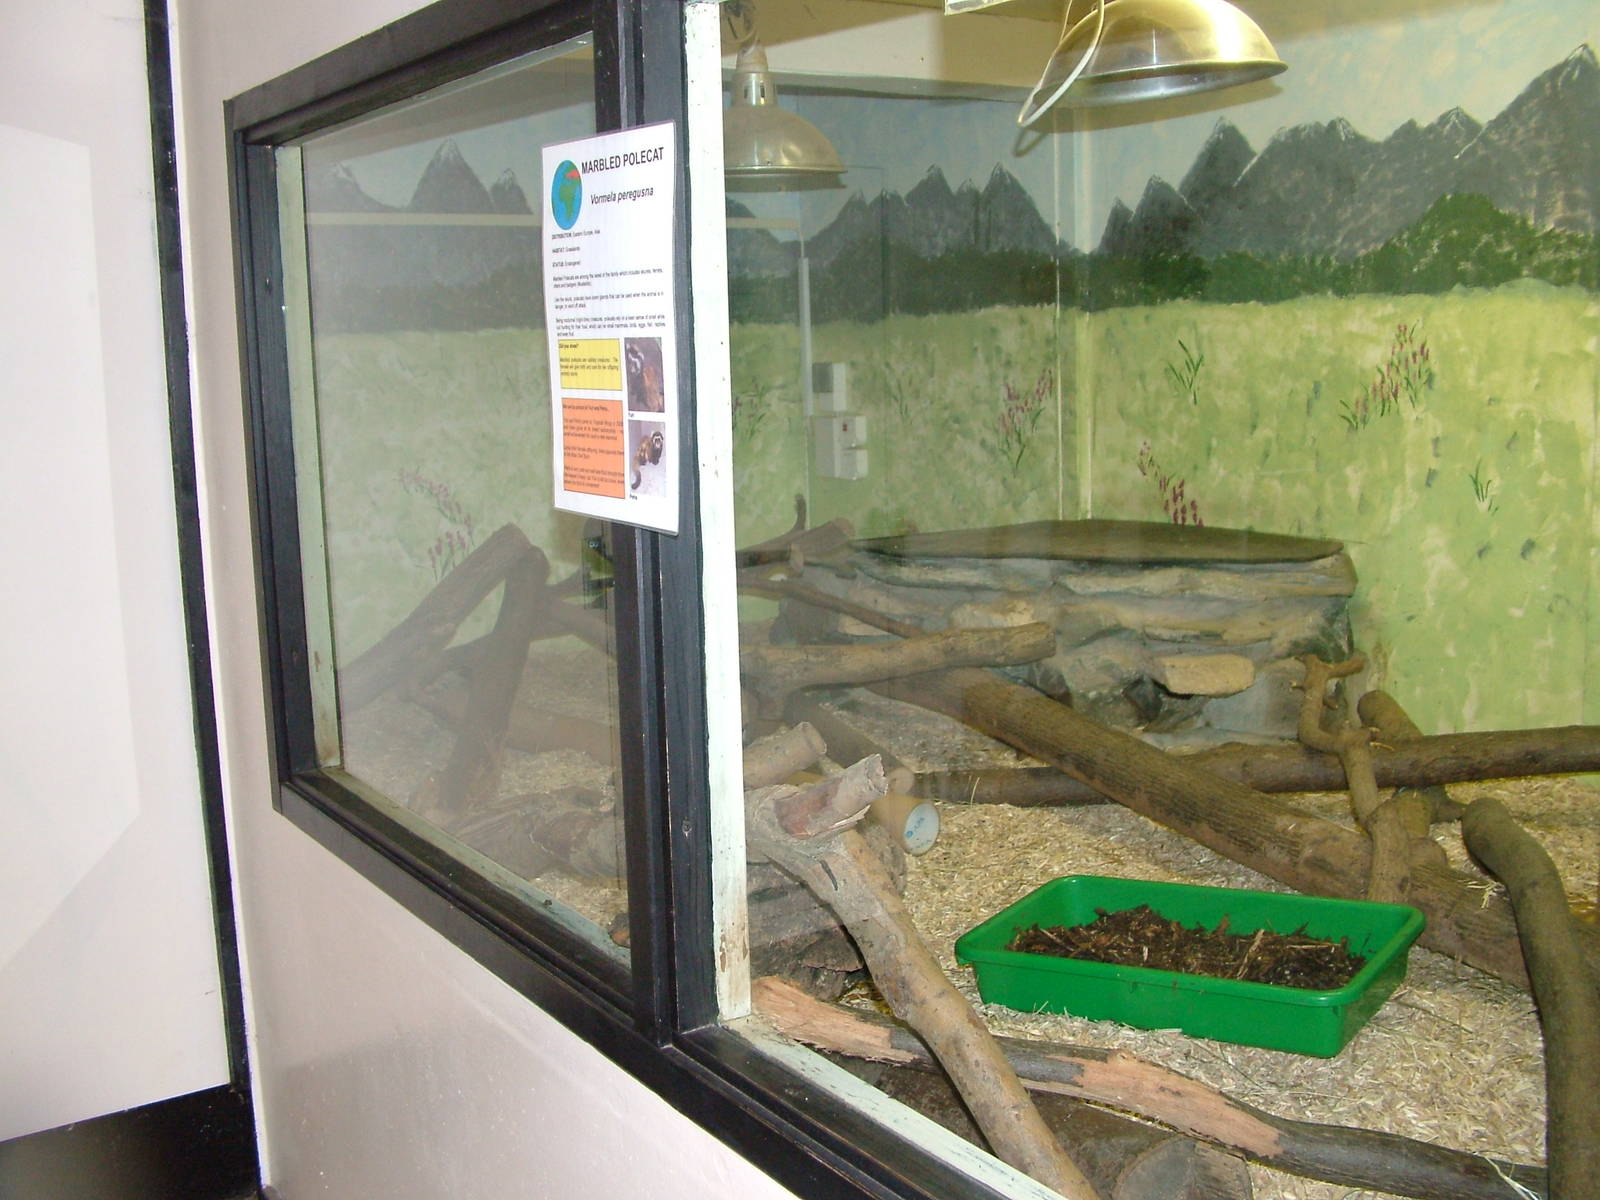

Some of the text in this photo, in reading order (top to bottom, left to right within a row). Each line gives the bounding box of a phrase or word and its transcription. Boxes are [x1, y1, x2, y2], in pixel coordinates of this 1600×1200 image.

[581, 146, 664, 174] MARBLED POLECAT
[590, 187, 654, 205] Vormela peregusna
